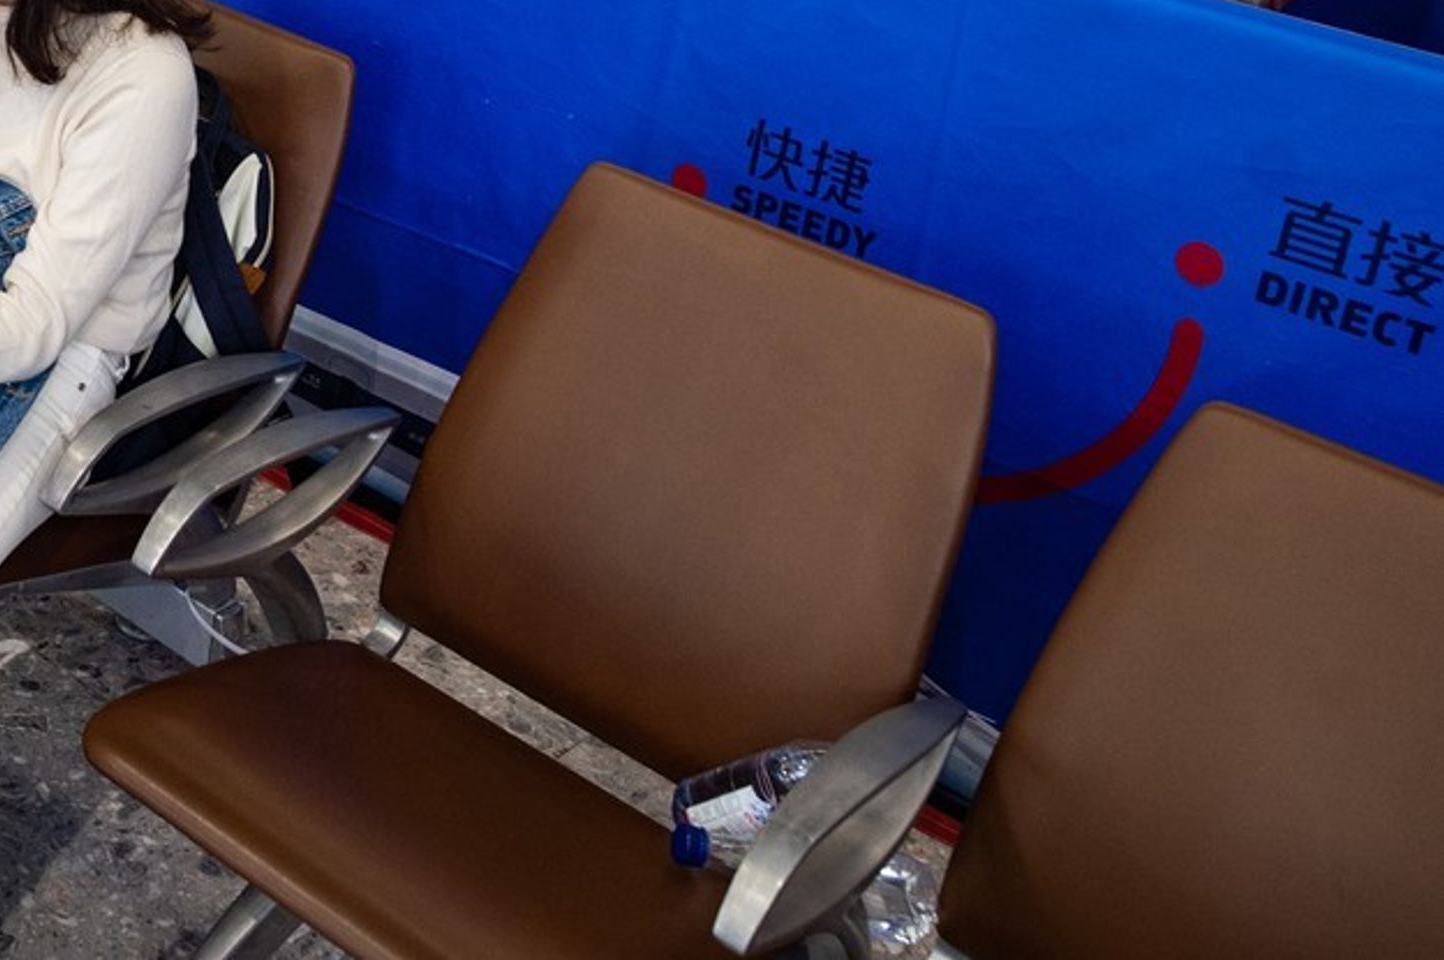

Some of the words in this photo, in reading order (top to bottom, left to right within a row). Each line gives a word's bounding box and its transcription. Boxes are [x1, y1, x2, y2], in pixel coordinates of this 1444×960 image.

[746, 118, 874, 214] 快捷
[729, 183, 876, 258] SPEEDY
[1268, 195, 1444, 308] 直接
[1255, 270, 1436, 355] DIRECT
